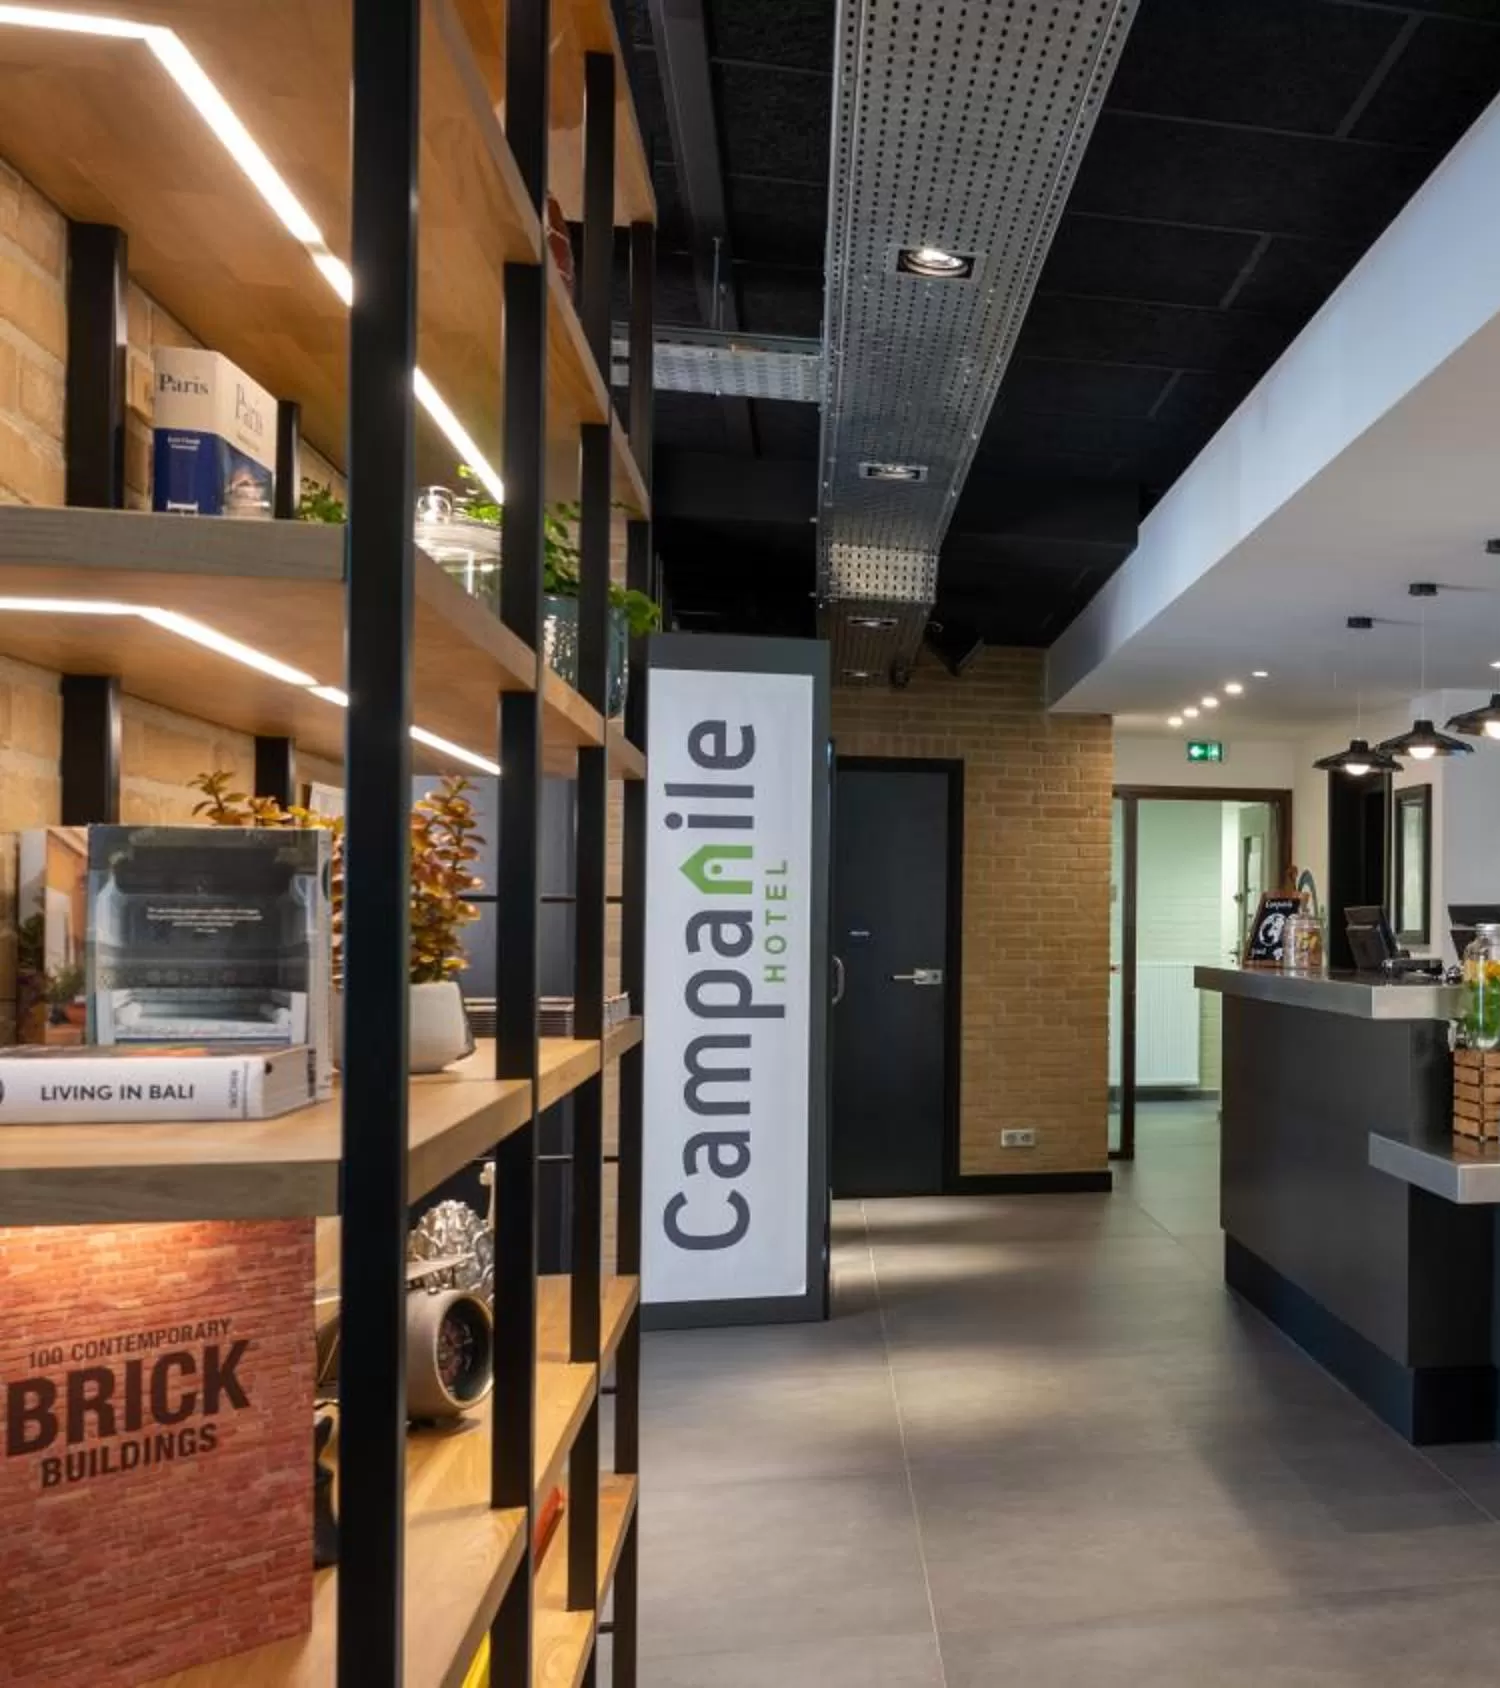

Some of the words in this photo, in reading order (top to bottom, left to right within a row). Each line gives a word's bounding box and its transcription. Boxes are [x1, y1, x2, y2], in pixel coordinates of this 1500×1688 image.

[159, 373, 209, 395] Paris
[764, 860, 787, 982] HOTEL
[662, 719, 785, 1251] Campanile
[40, 1084, 113, 1101] LIVING
[119, 1085, 142, 1100] IN
[149, 1084, 195, 1100] BALI
[28, 1348, 63, 1368] 100
[71, 1318, 232, 1361] CONTEMPORARY
[6, 1339, 251, 1458] BRICK
[41, 1423, 218, 1488] BUILDINGS
